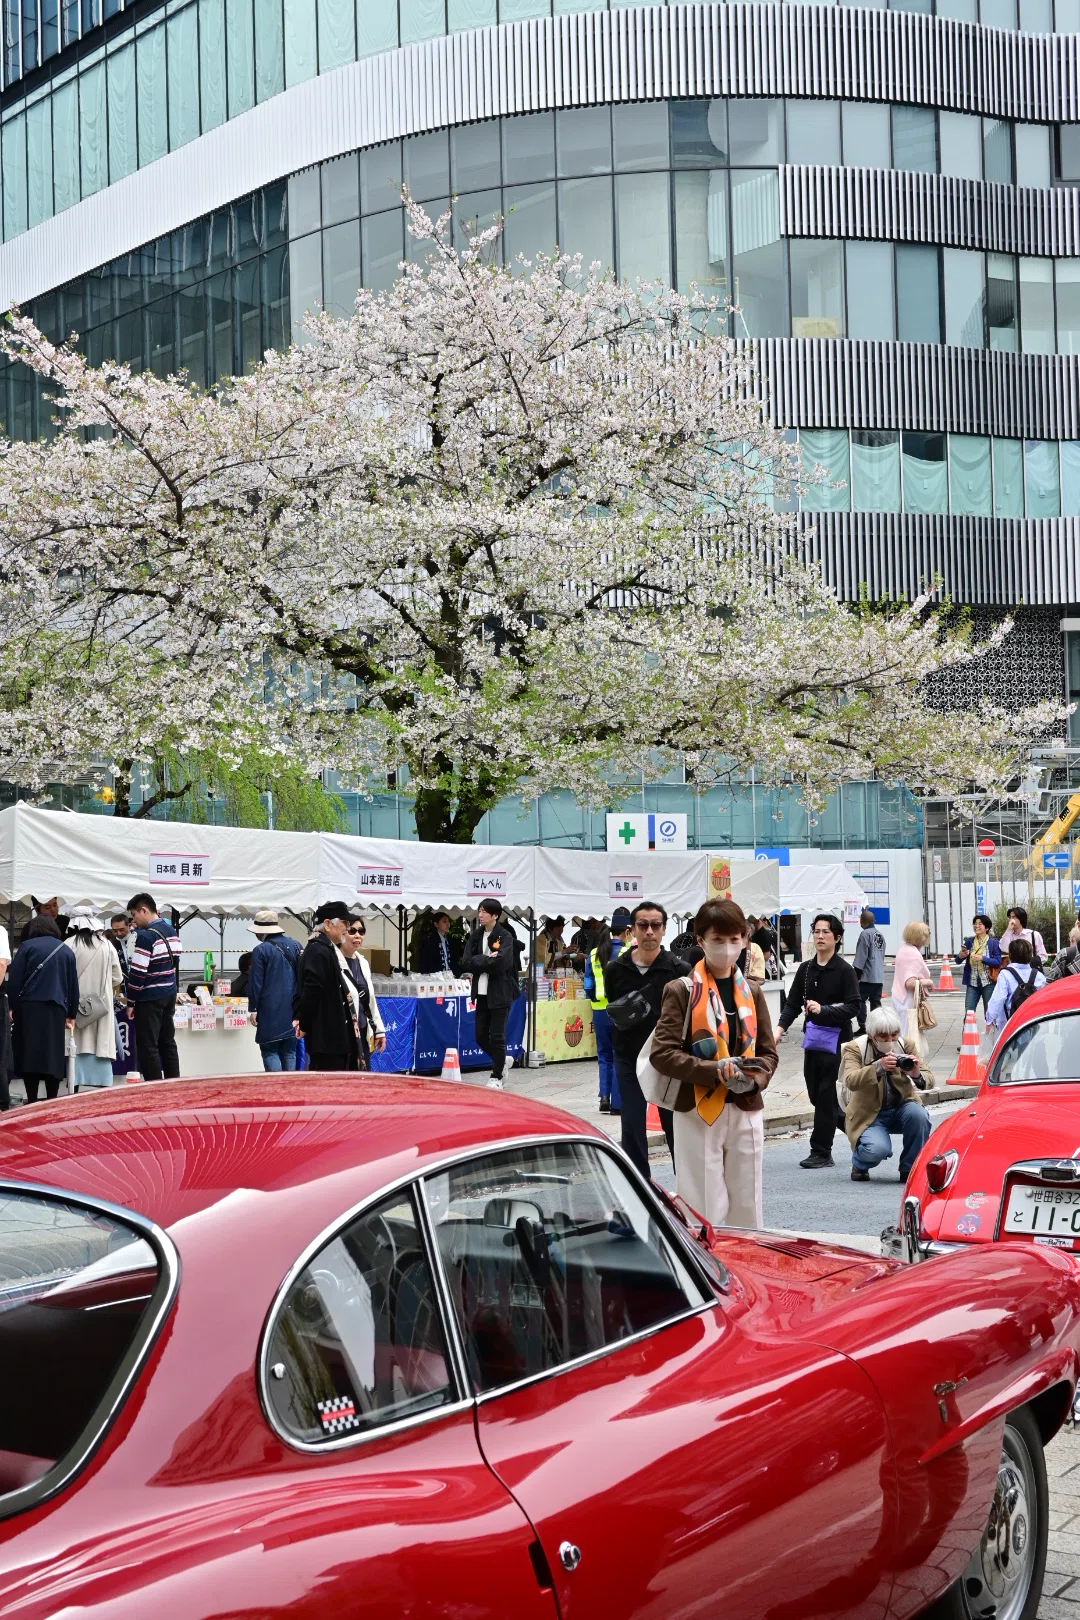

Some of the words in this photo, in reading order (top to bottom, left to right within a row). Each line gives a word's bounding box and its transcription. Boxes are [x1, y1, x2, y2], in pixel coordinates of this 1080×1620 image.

[156, 864, 177, 874] 日本橋
[181, 863, 203, 877] 貝新
[361, 873, 400, 886] 山本海苔店
[473, 878, 501, 889] にんべん
[1013, 1211, 1024, 1223] と
